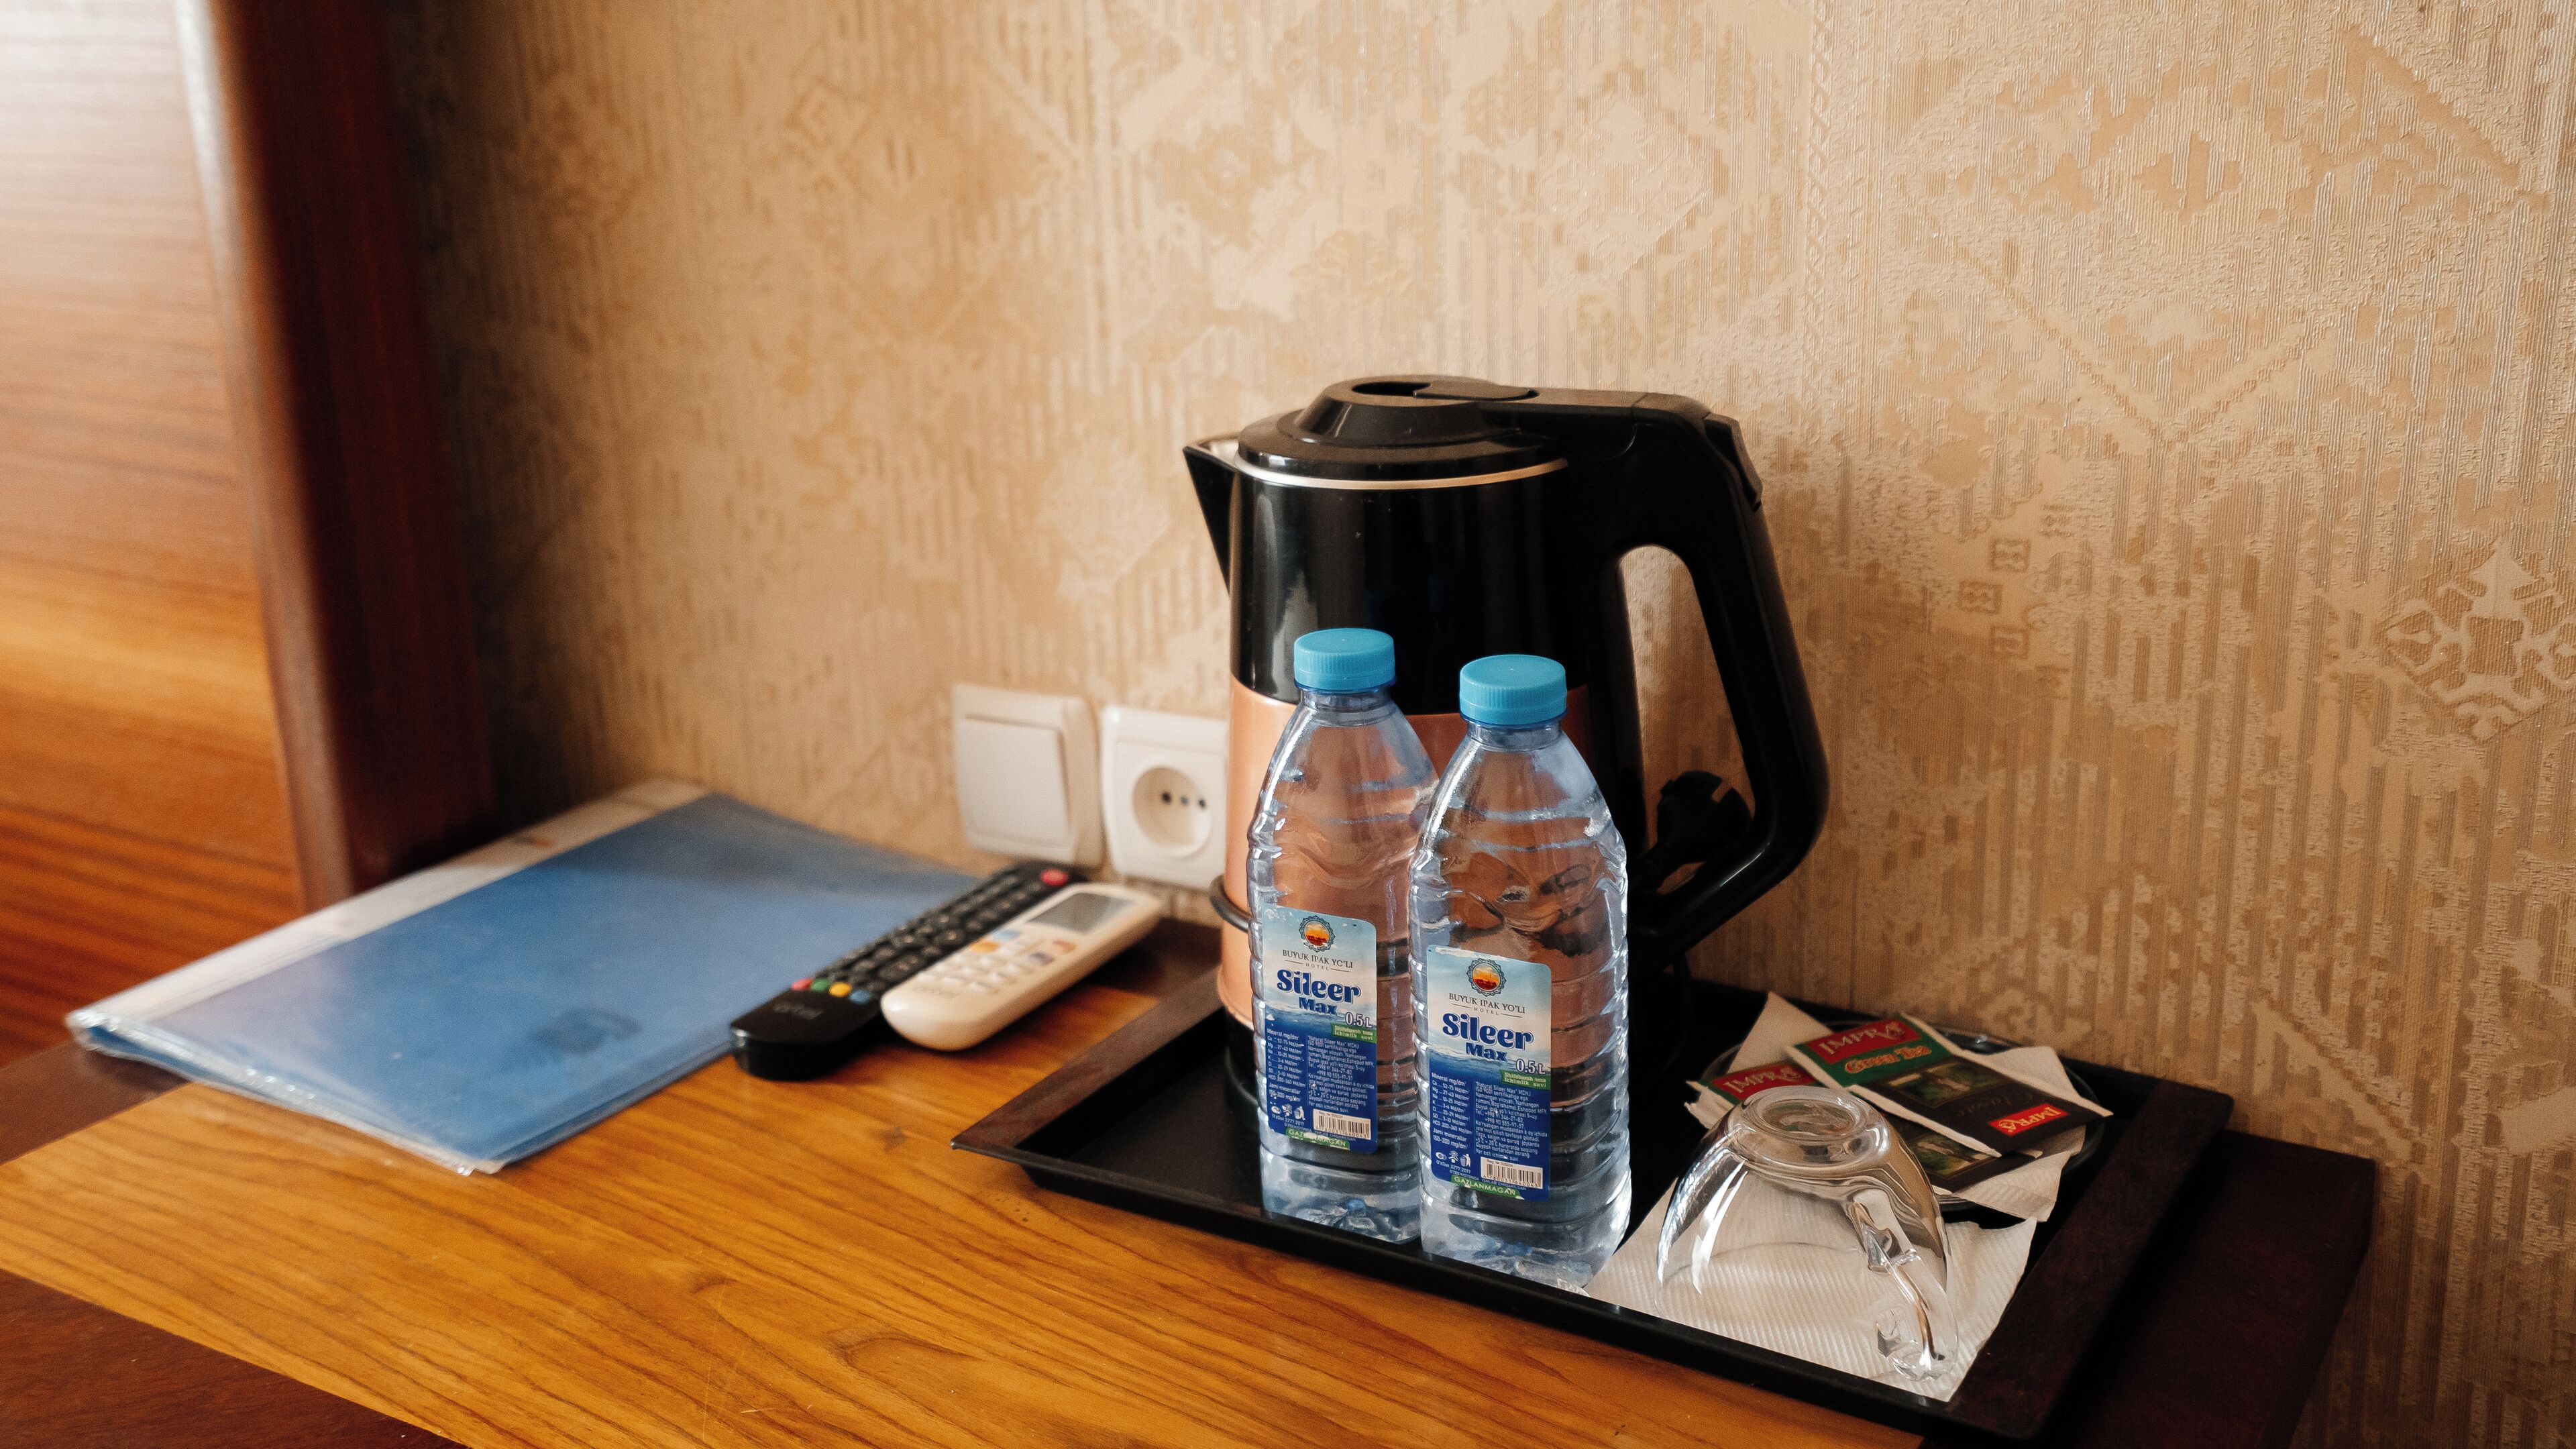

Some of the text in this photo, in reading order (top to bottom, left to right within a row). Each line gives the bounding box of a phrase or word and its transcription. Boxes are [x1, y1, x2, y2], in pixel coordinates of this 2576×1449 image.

[1283, 949, 1309, 961] BUYUK
[1311, 956, 1329, 965] IPAK
[1305, 963, 1329, 971] HOTEL
[1277, 969, 1361, 1004] Sileer
[1299, 997, 1338, 1016] Max
[1449, 993, 1525, 1014] BUYUK IPAK YO'LI
[1442, 1013, 1534, 1051] Sileer
[1466, 1042, 1508, 1062] Max
[1844, 1046, 1932, 1073] Green Tea
[1998, 1106, 2061, 1133] IMPRA
[1454, 1176, 1516, 1195] GAZLANMAGAN
